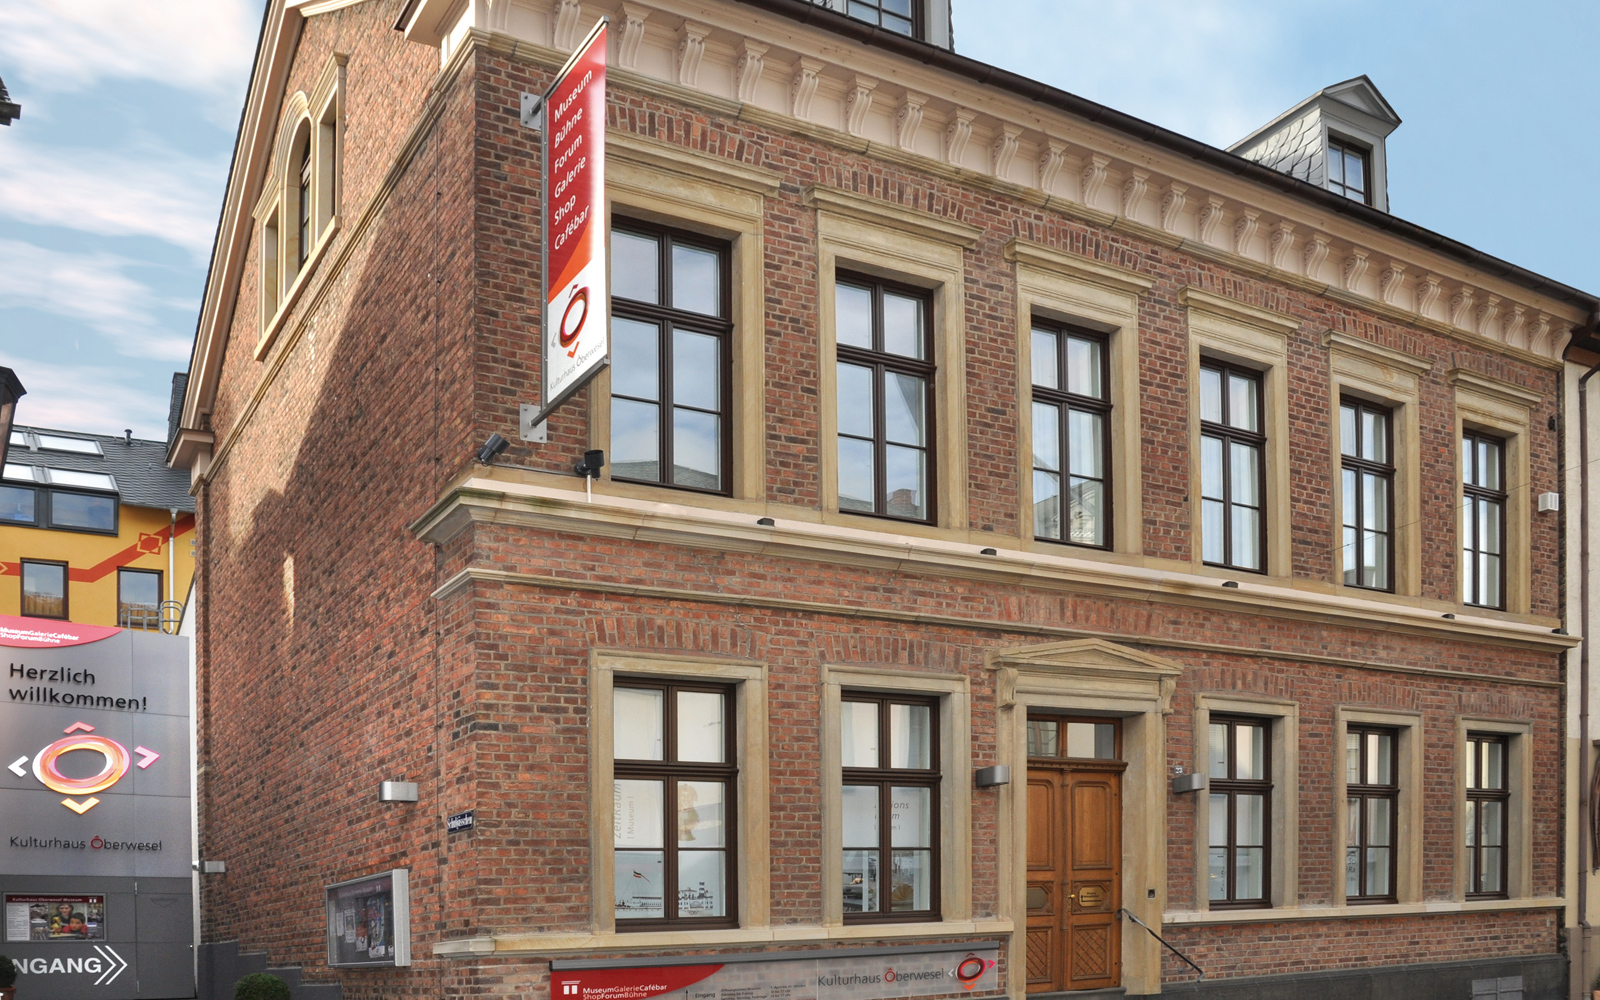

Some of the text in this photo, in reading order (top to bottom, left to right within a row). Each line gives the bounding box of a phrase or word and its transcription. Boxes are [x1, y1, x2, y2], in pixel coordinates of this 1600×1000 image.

[554, 70, 592, 122] Museum
[554, 107, 583, 148] Bühne
[554, 134, 582, 174] Forum
[554, 156, 586, 198] Galerie
[554, 194, 576, 225] Shop
[554, 205, 589, 250] Cafébar
[9, 663, 95, 684] Herzlich
[9, 686, 147, 710] willkommen!
[10, 836, 86, 849] Kulturhaus
[11, 957, 102, 974] NGANG
[583, 985, 667, 994] MuseumGalerieCafébar
[818, 974, 881, 987] Kulturhaus
